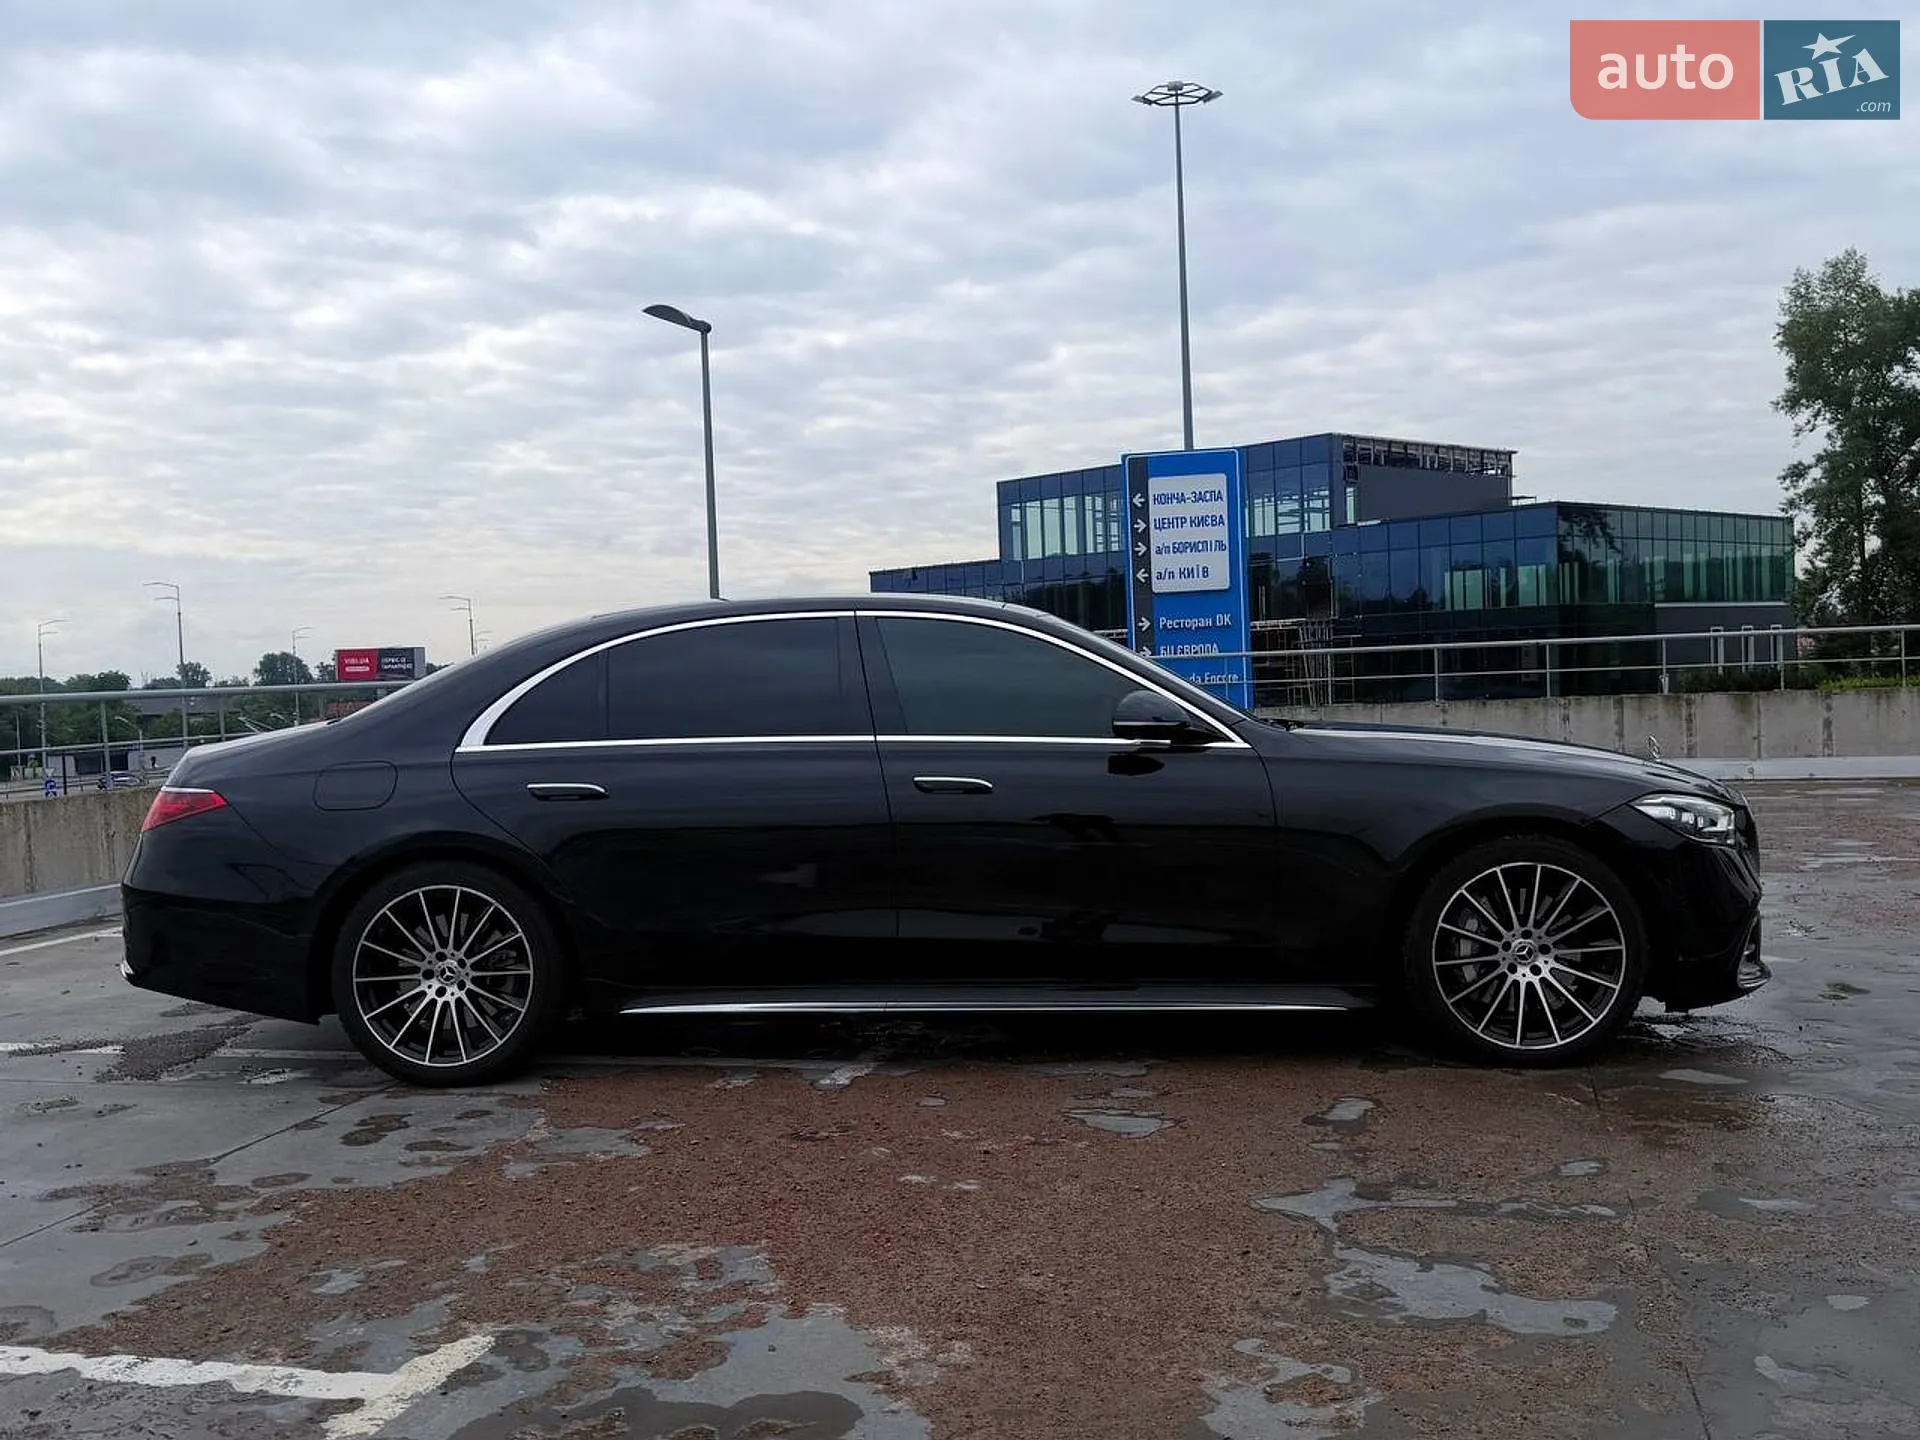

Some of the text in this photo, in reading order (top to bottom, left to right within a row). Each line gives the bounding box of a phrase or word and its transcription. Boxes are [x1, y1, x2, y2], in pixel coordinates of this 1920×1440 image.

[1153, 490, 1224, 504] КОНЧА-ЗАСПА
[1153, 514, 1225, 531] ЦЕНТР КИЄВА
[1155, 542, 1171, 555] а/п
[1156, 568, 1175, 580] а/п
[1159, 617, 1212, 630] Ресторан
